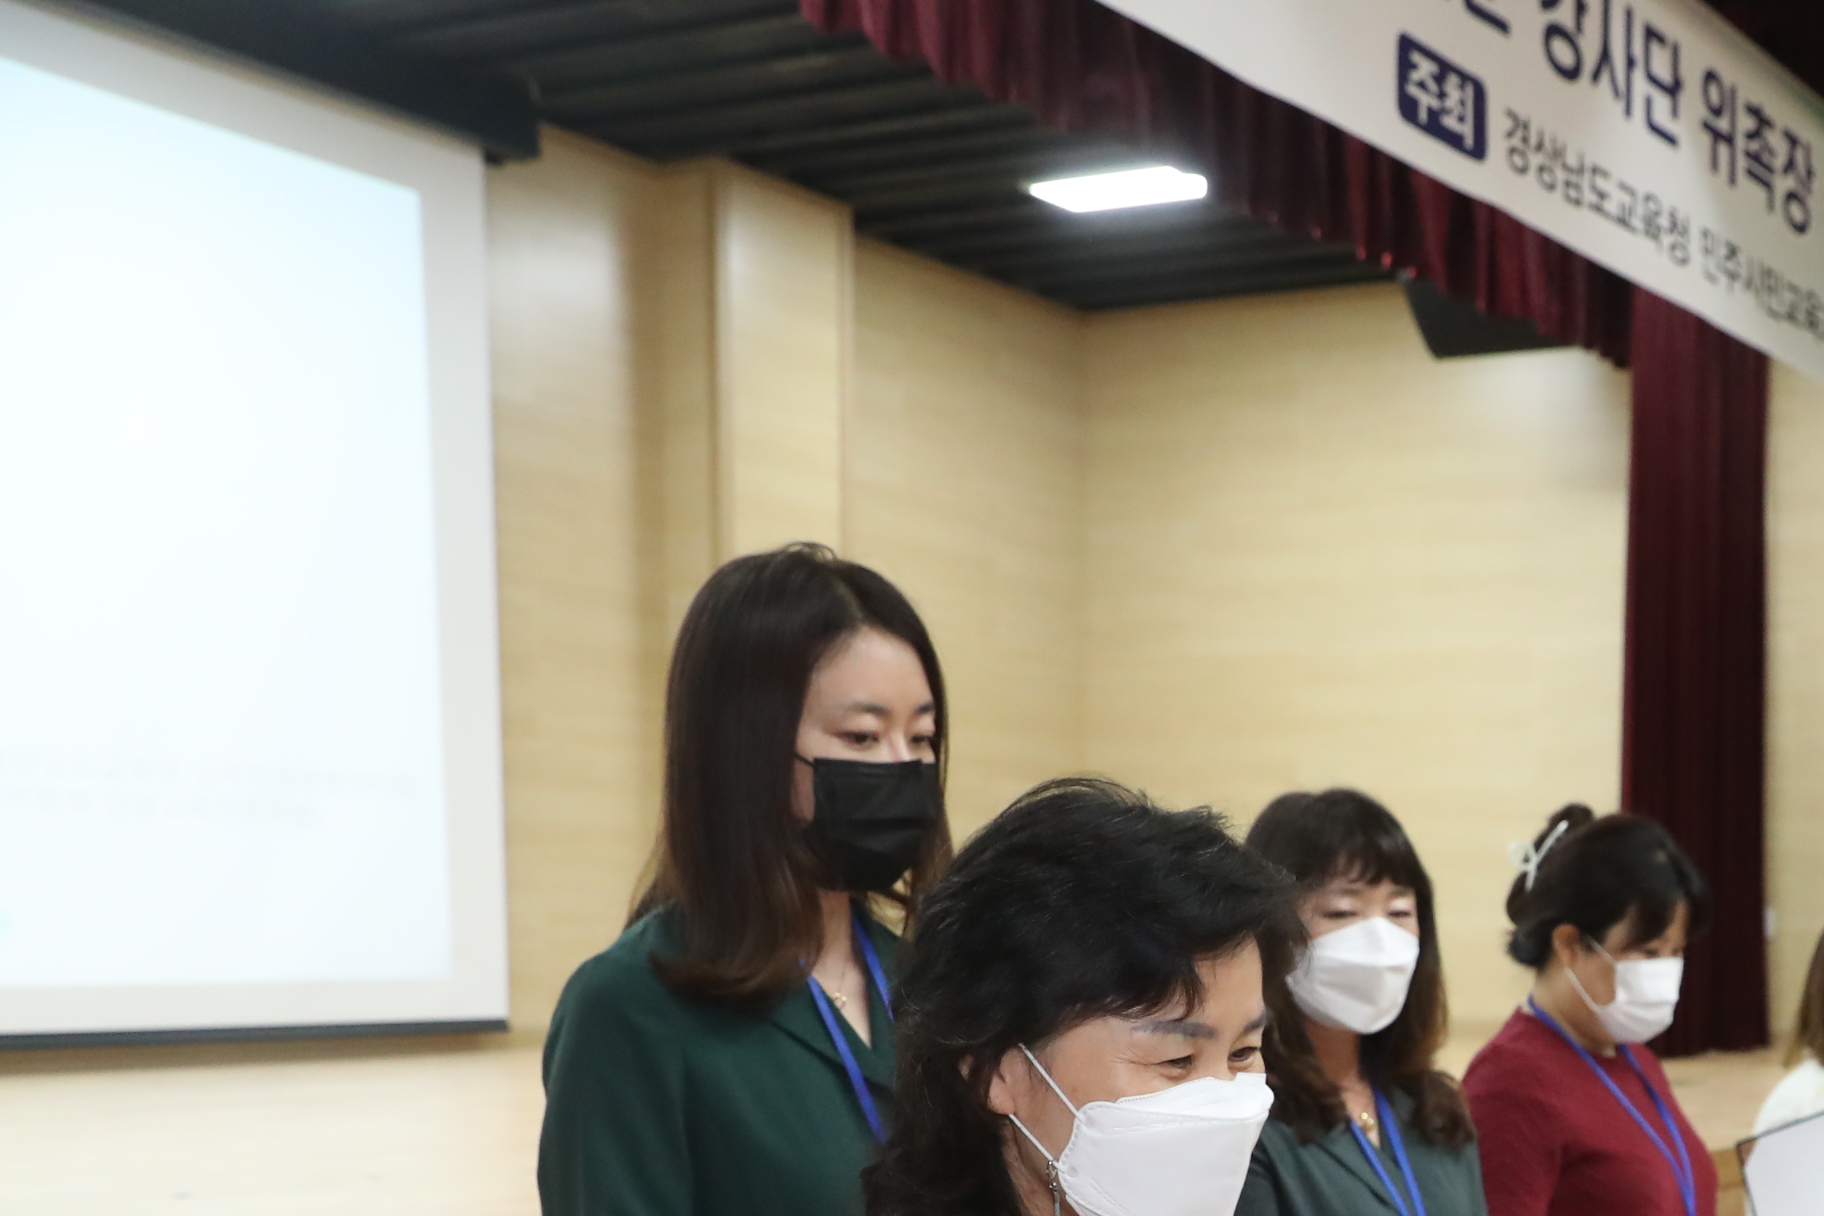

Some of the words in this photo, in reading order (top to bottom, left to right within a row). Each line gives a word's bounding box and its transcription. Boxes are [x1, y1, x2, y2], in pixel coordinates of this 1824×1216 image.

[1405, 48, 1474, 151] 주최
[1702, 69, 1814, 234] 위촉장
[1505, 106, 1692, 267] 경상남도교육청
